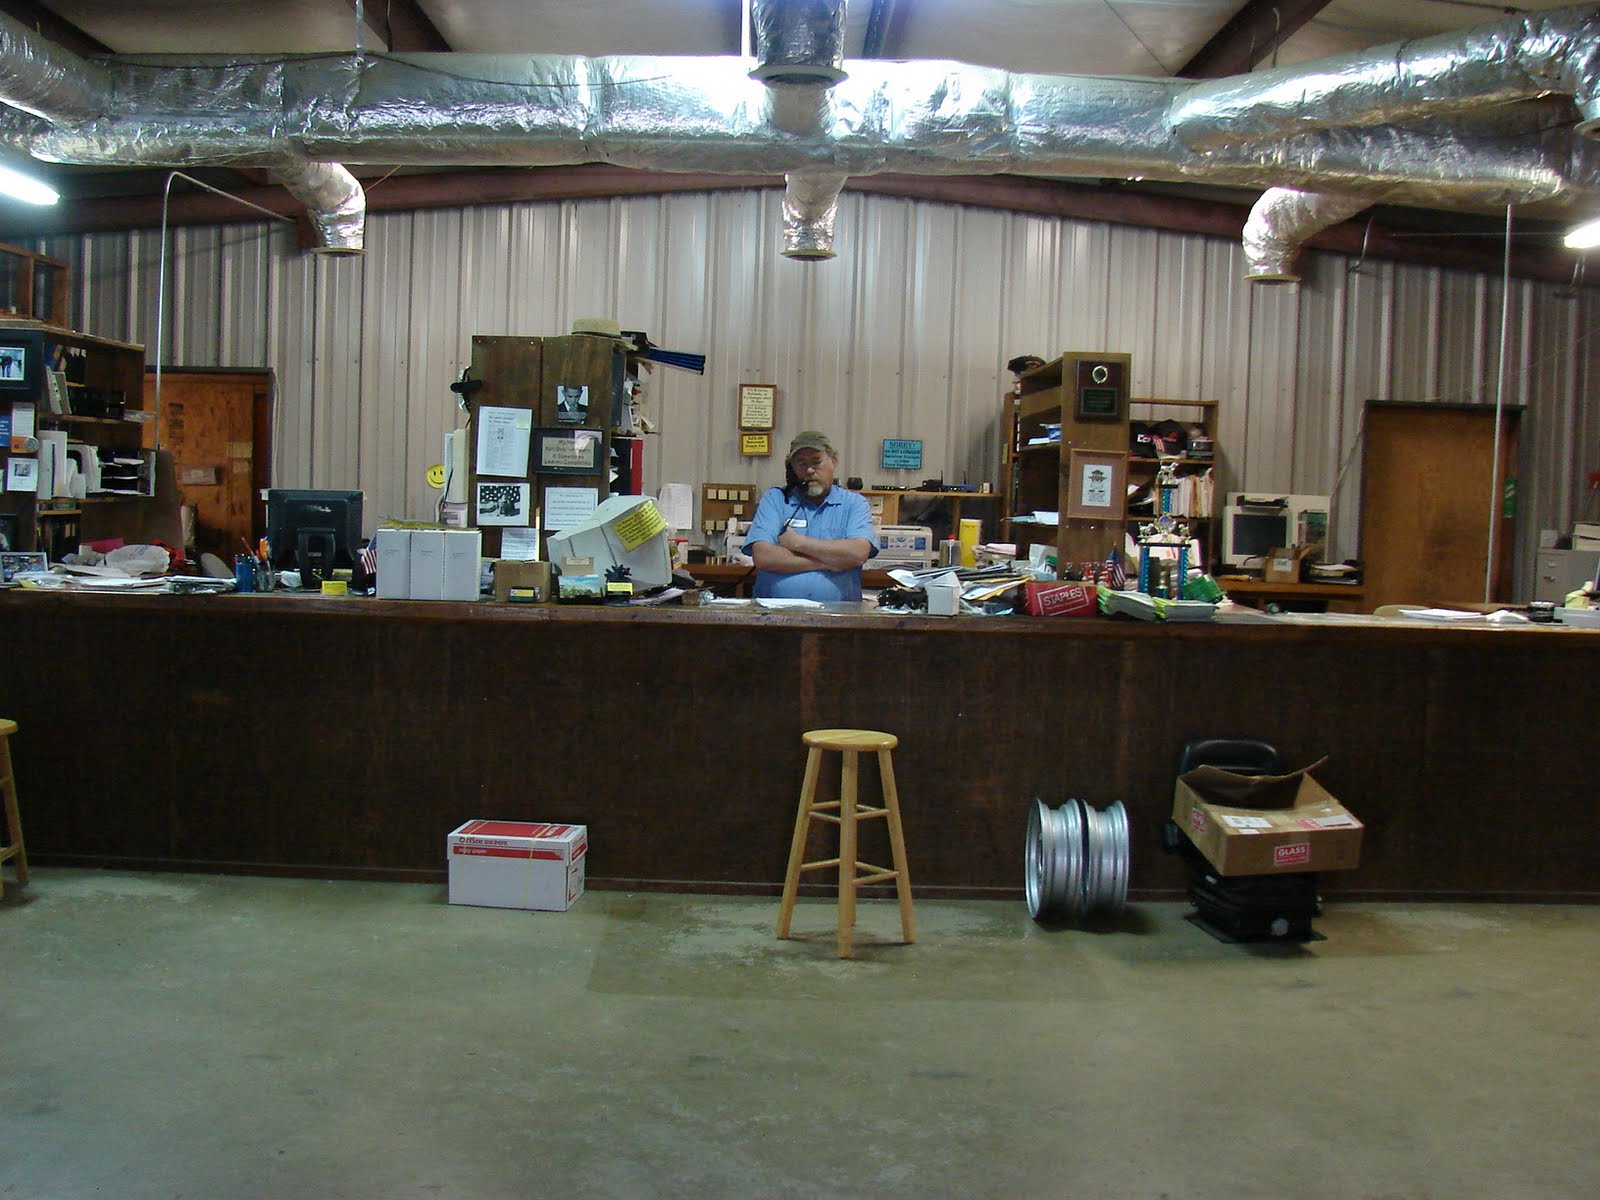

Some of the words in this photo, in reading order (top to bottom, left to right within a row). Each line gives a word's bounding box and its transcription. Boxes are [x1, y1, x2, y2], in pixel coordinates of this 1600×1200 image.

[1043, 587, 1083, 606] STAPLES
[459, 836, 484, 844] Office
[1278, 846, 1306, 857] GLASS
